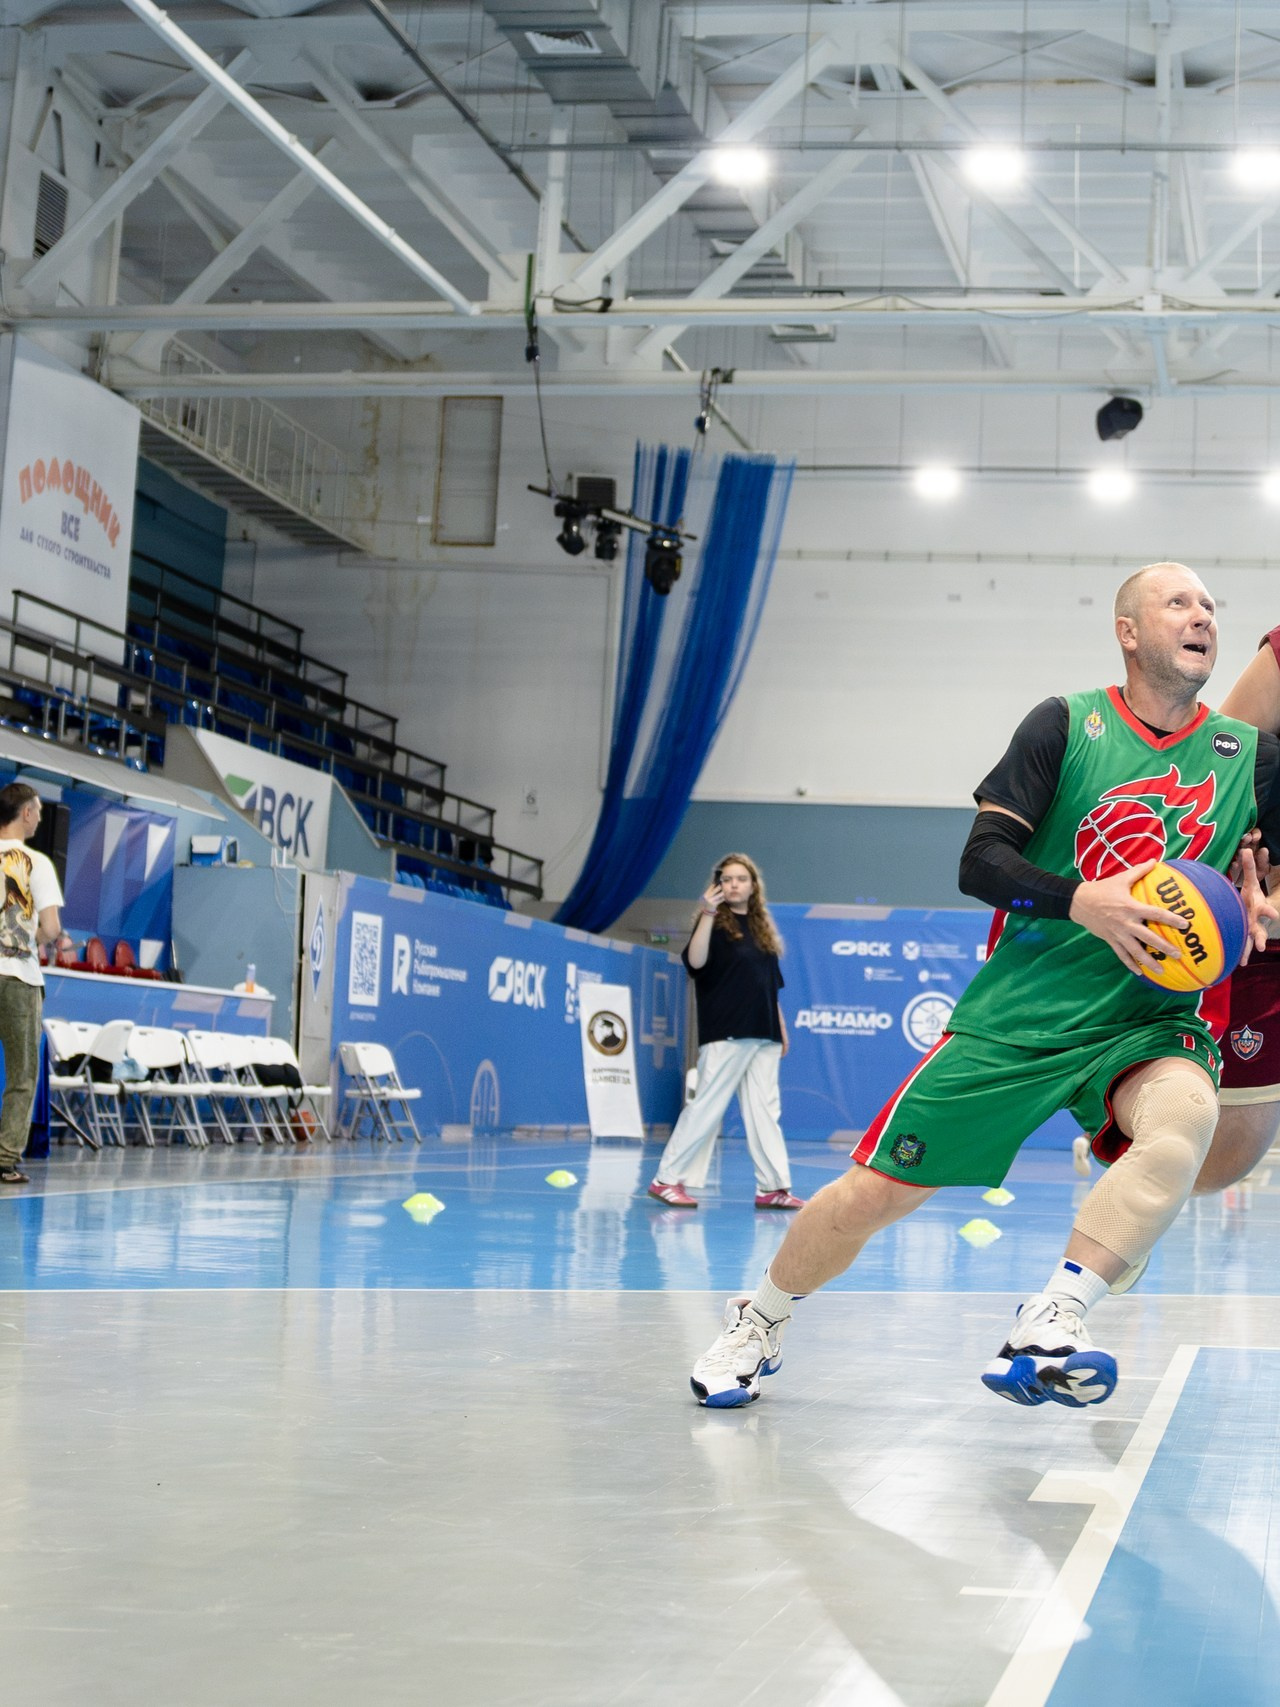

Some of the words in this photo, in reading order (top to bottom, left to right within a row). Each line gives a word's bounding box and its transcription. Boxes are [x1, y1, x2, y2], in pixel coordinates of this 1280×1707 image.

[19, 457, 121, 548] ПОМОЩНИК
[60, 511, 81, 542] ВСЕ
[1215, 739, 1238, 750] РФБ
[857, 941, 892, 957] ВСК
[513, 960, 547, 1009] ВСК
[794, 1010, 893, 1030] ДИНАМО
